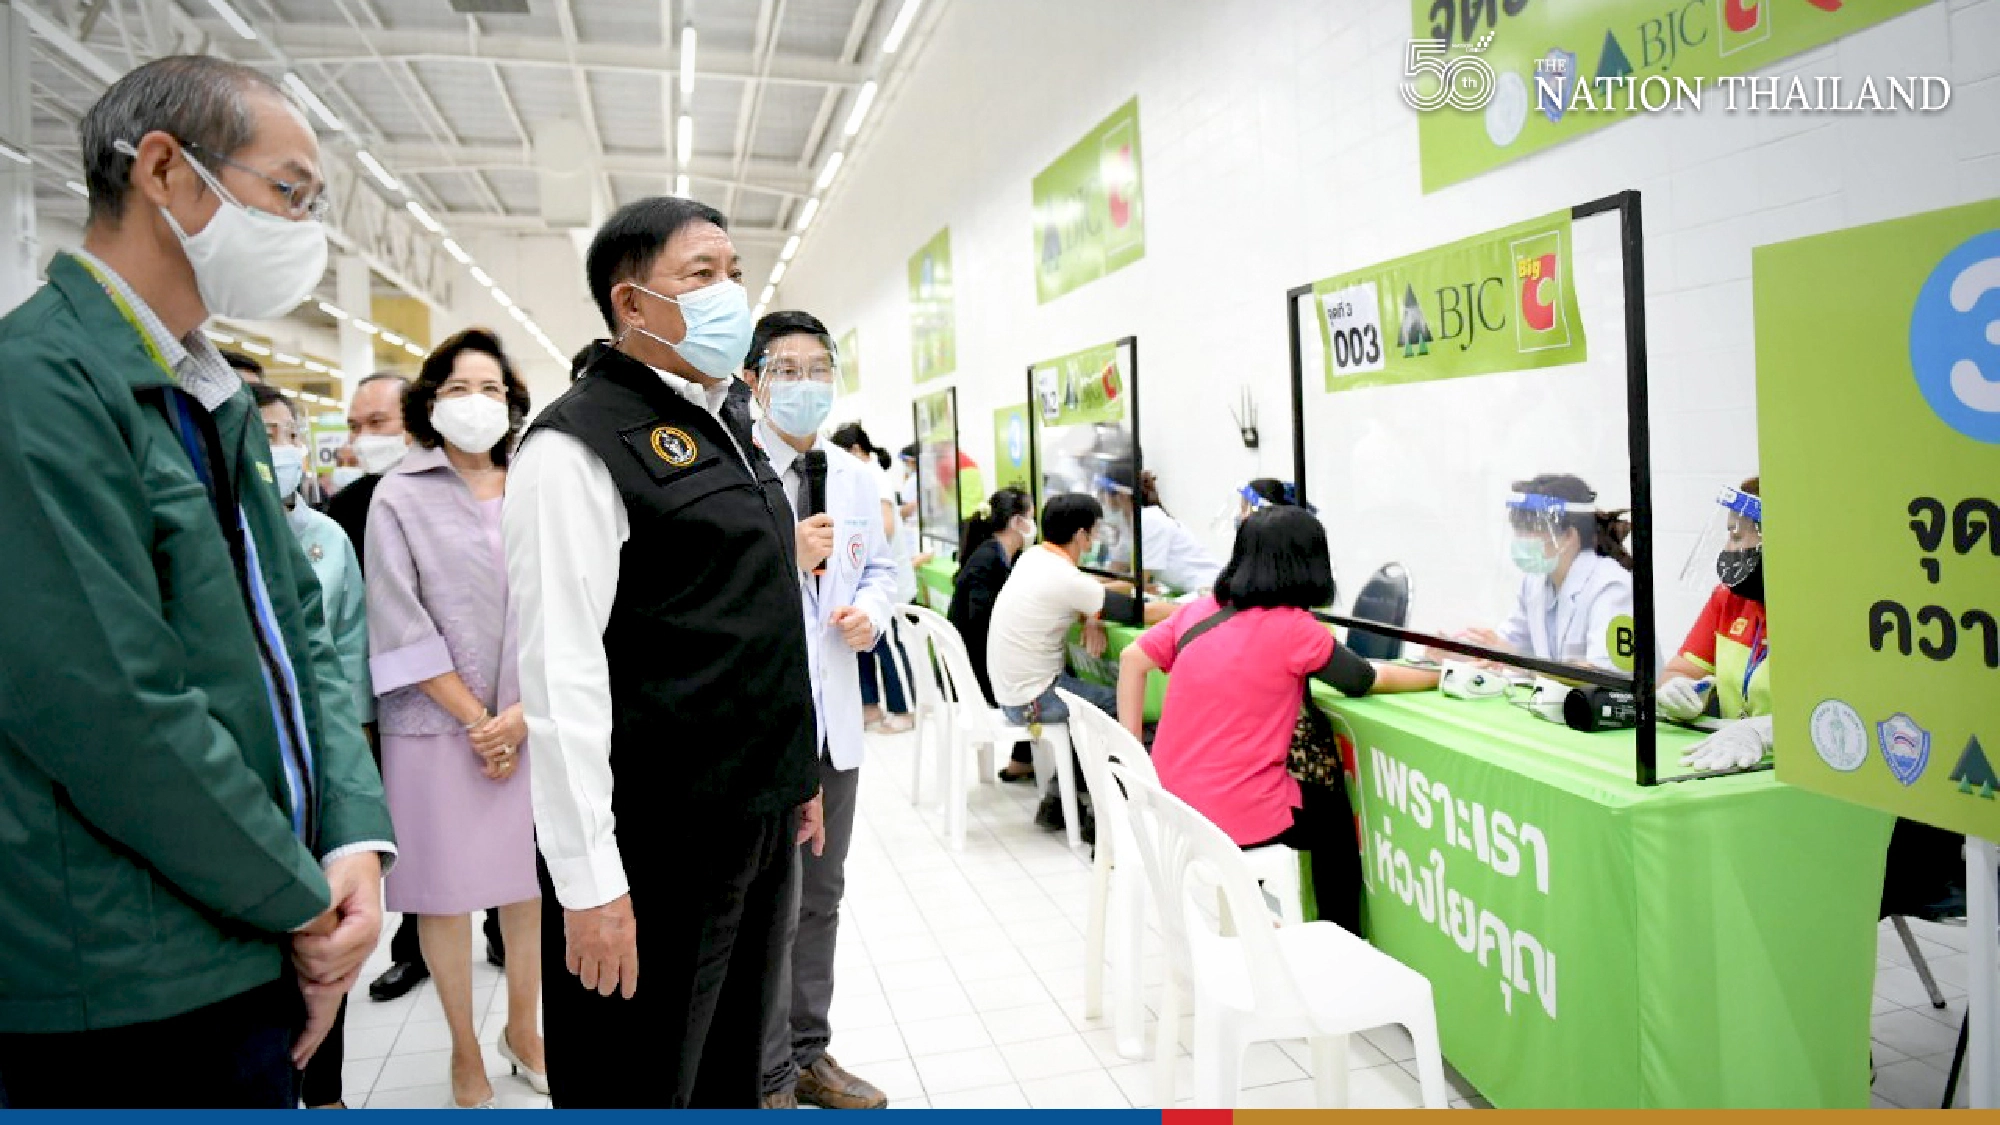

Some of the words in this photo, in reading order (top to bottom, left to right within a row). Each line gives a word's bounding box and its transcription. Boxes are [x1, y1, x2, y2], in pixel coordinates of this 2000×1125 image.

[1637, 0, 1708, 71] BJC
[1518, 257, 1541, 280] Big
[1521, 252, 1557, 333] C
[1334, 323, 1380, 369] 003
[1435, 277, 1506, 351] BJC
[1908, 496, 2000, 583] จุด
[1371, 747, 1549, 895] เพราะเรา
[1375, 816, 1556, 1019] ห่วงใยคุณ
